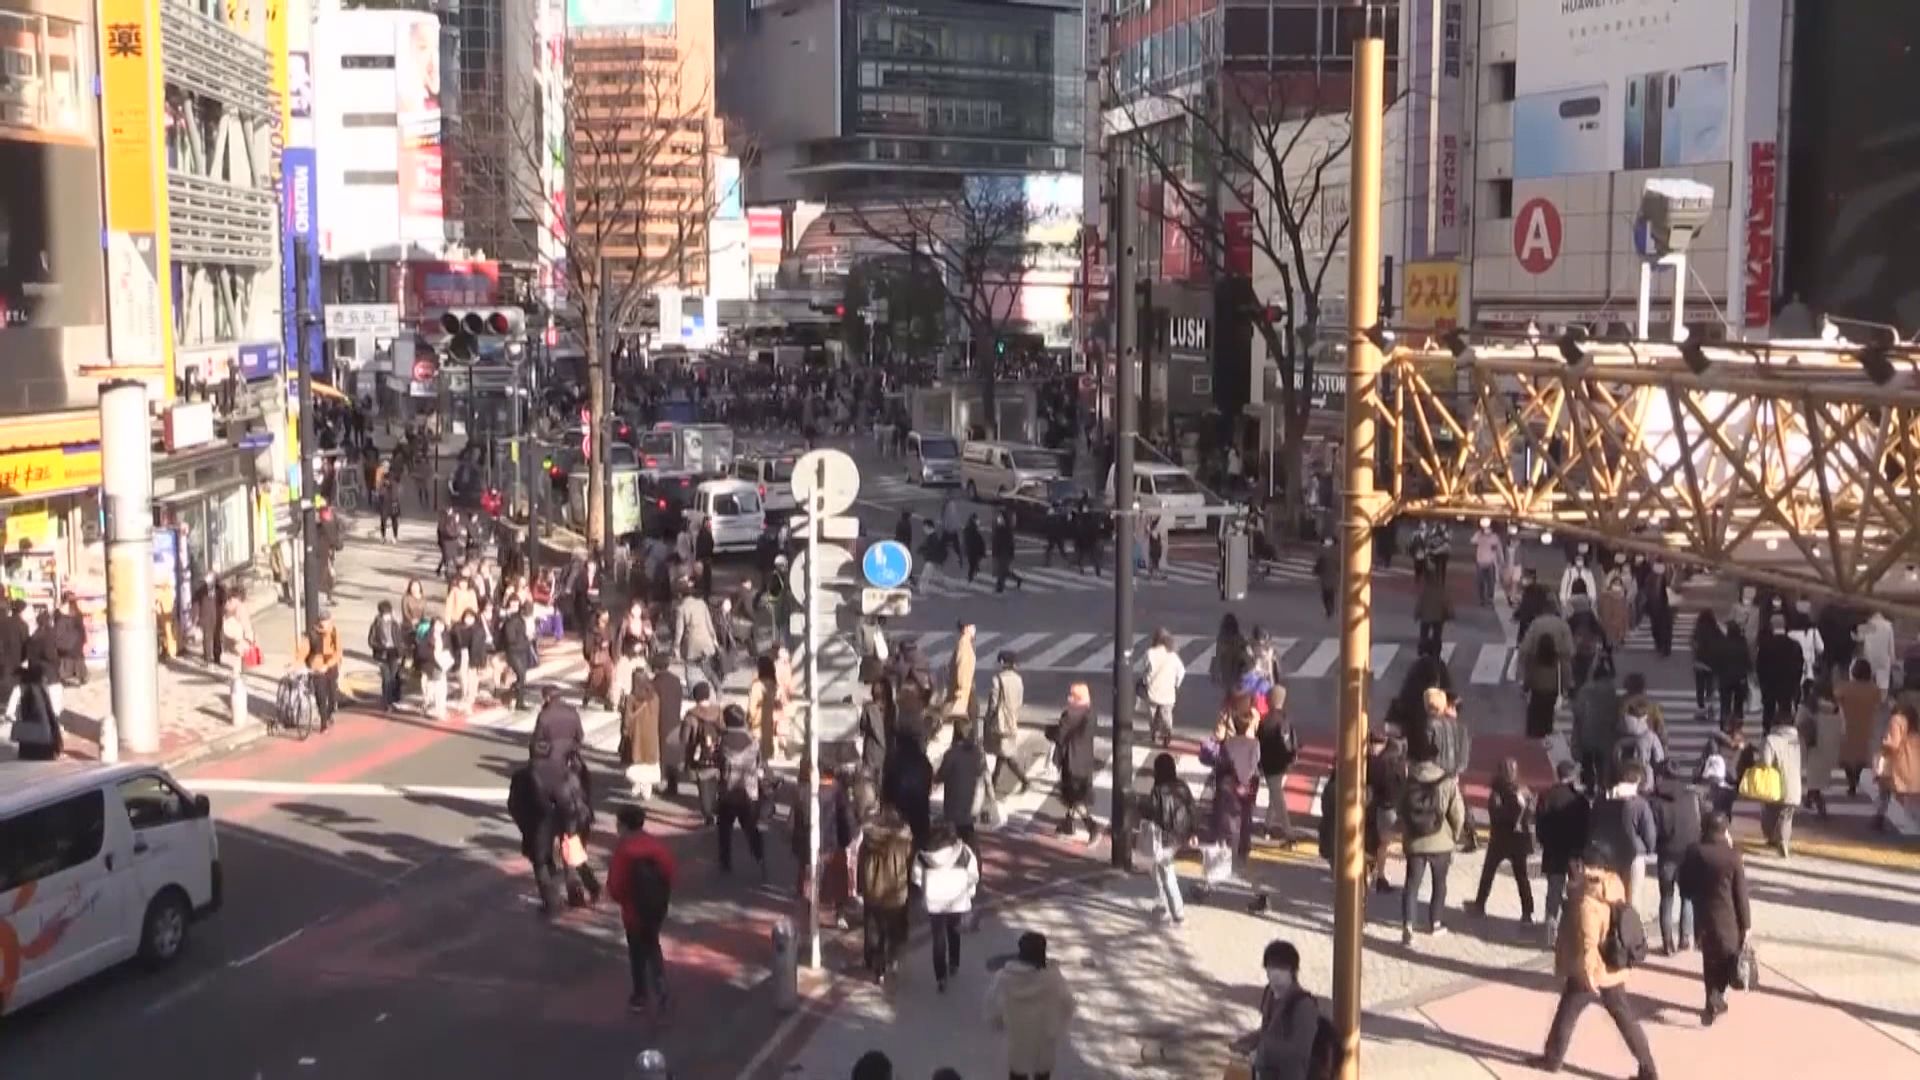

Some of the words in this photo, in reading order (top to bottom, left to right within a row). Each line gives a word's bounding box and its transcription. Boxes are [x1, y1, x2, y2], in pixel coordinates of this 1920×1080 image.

[107, 22, 143, 59] 薬
[1520, 206, 1554, 261] A
[1407, 272, 1458, 310] クスリ
[1169, 316, 1206, 349] LUSH
